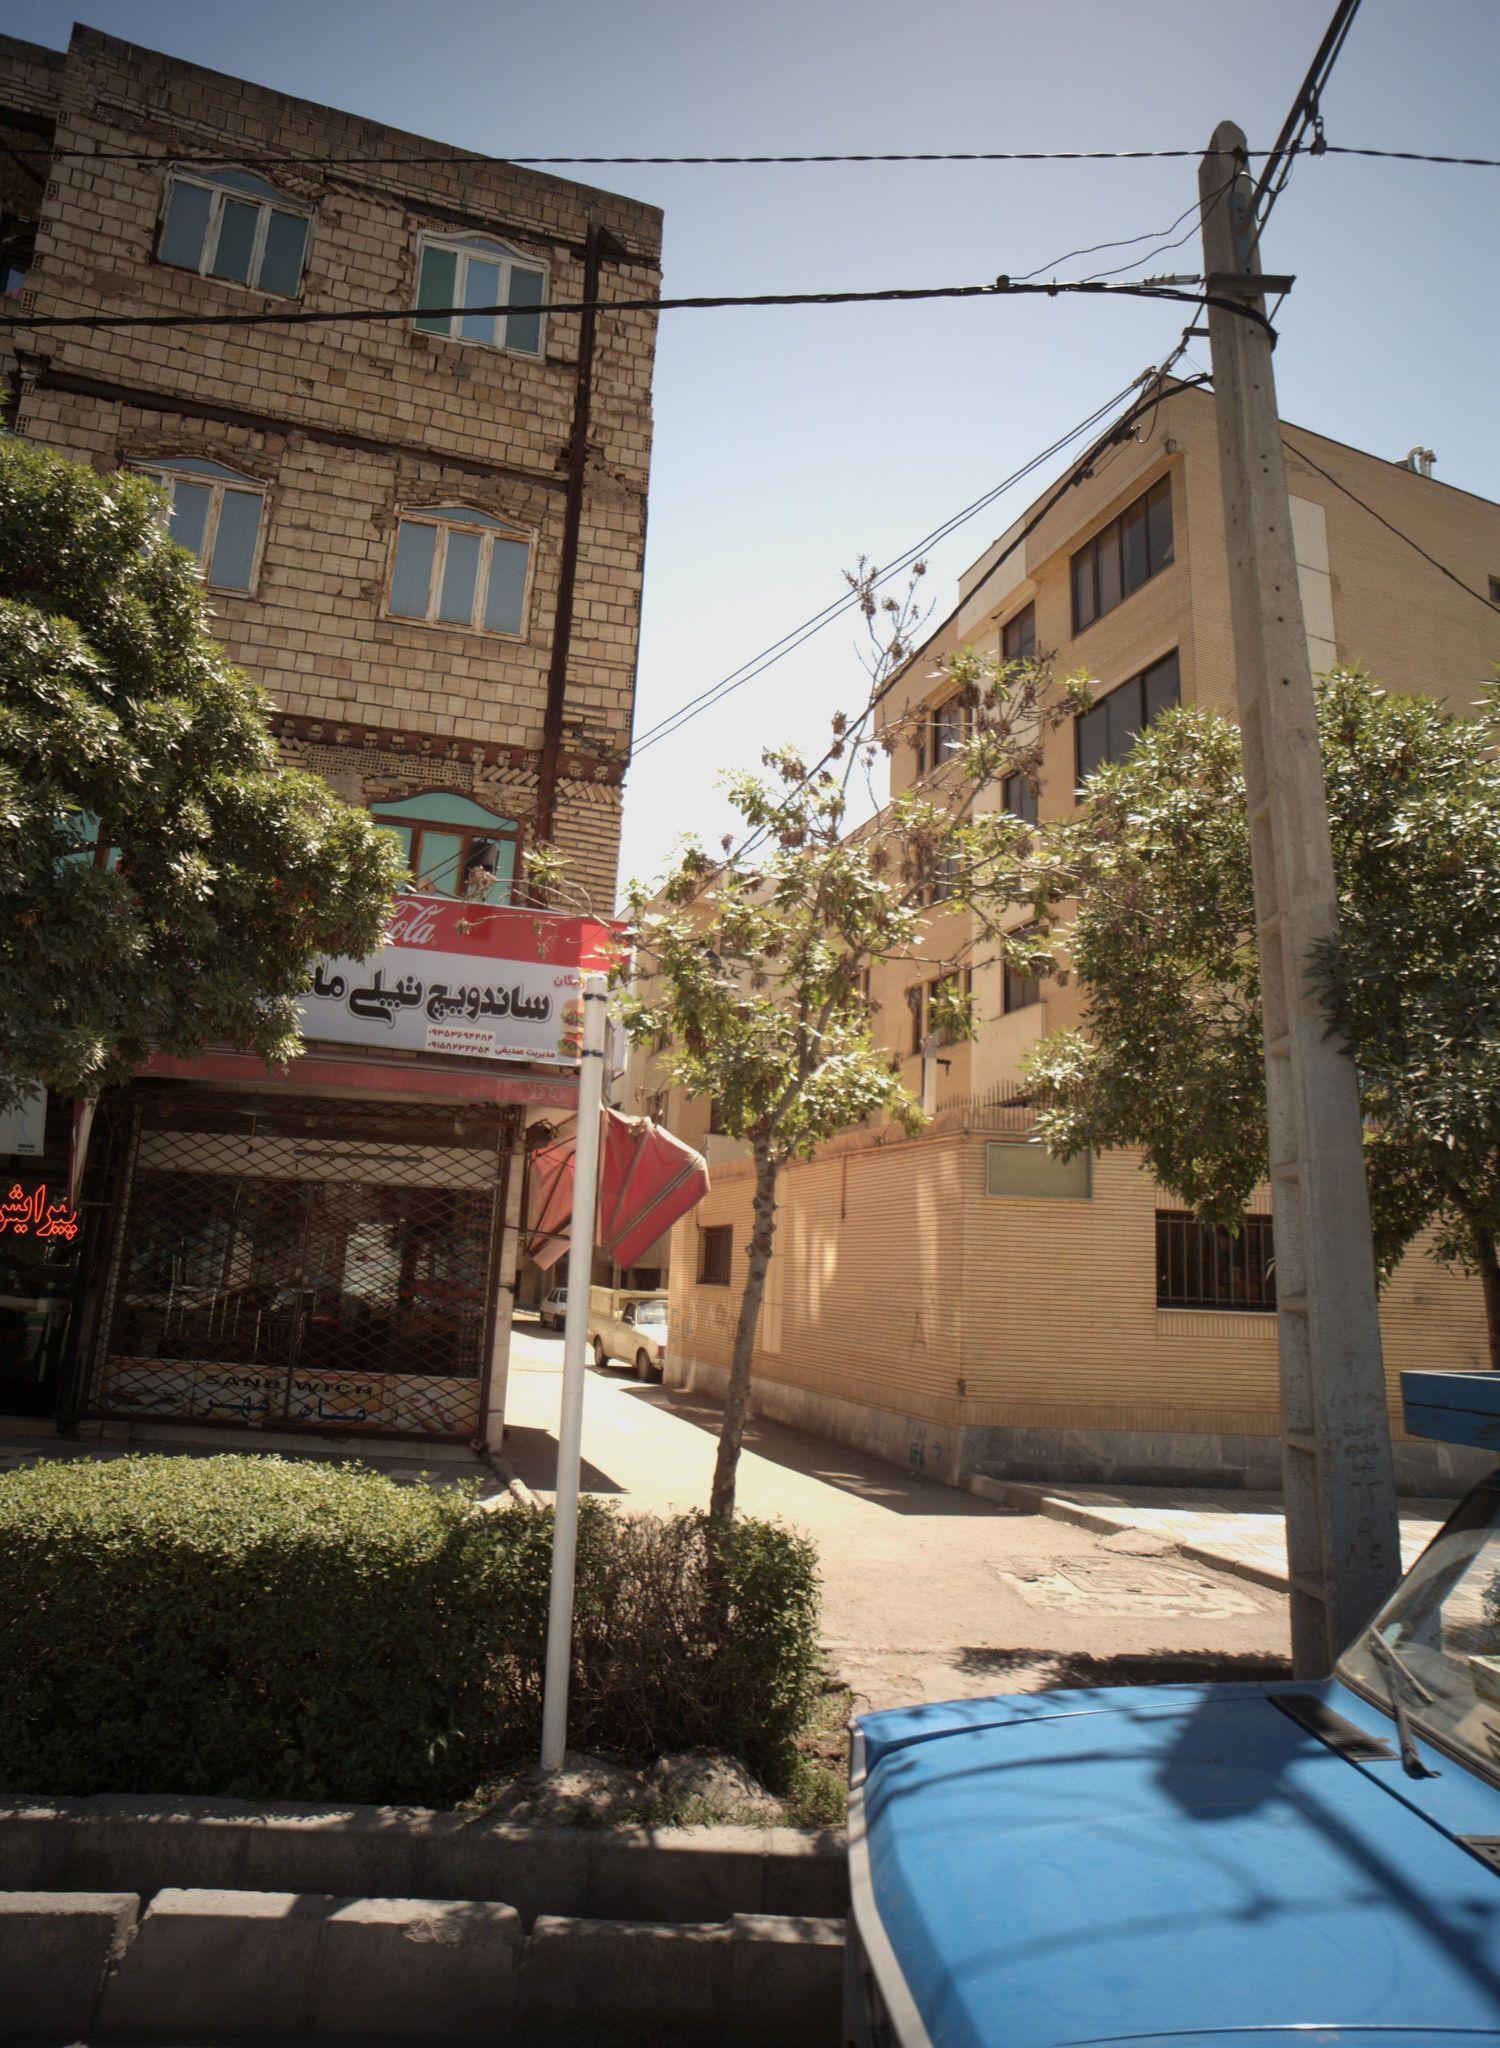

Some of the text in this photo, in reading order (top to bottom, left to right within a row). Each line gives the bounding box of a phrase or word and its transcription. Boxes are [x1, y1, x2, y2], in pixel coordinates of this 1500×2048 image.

[349, 968, 423, 1022] تپلی
[426, 983, 551, 1022] ساندویچ
[495, 1044, 525, 1056] صدیقی
[526, 1047, 556, 1059] مدیریت
[299, 1397, 367, 1421] ماه
